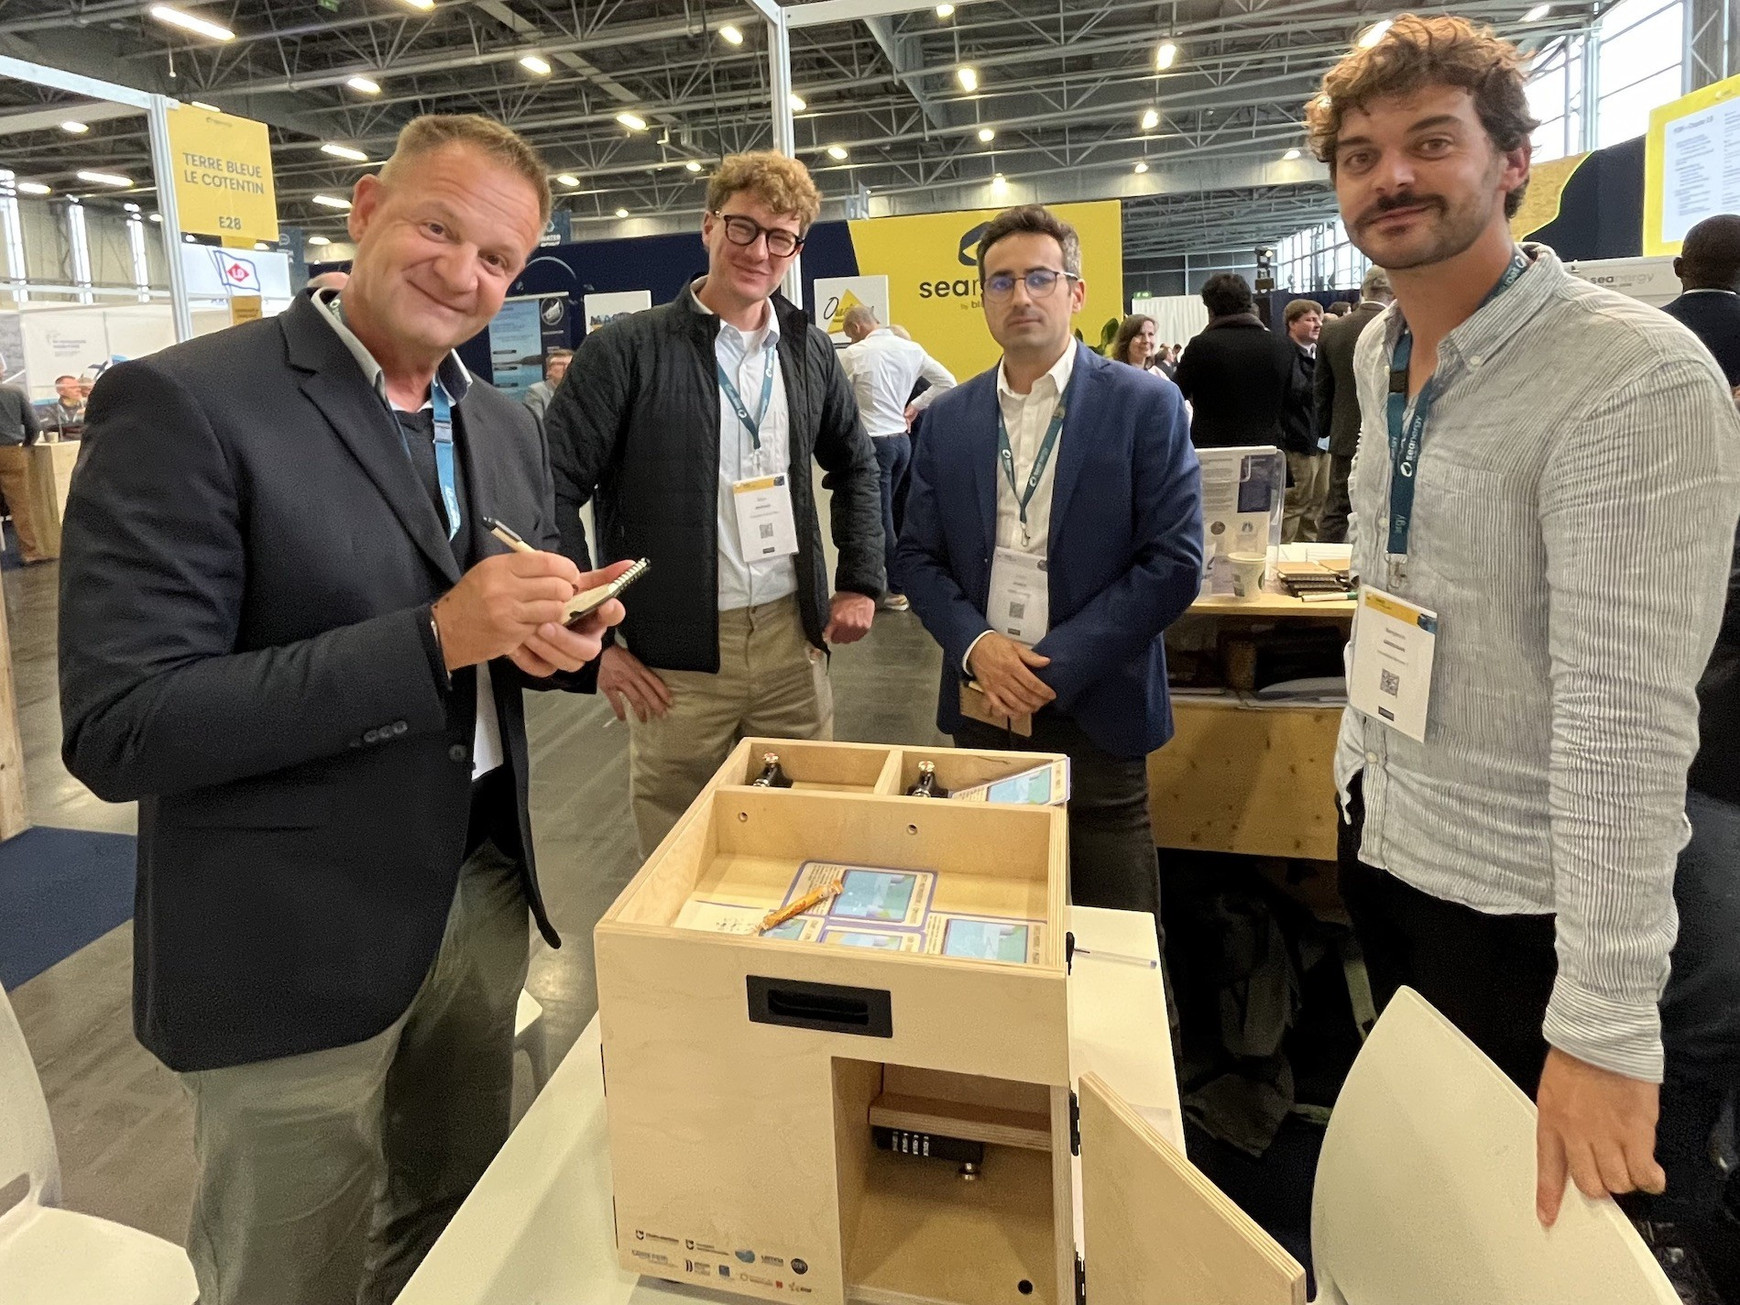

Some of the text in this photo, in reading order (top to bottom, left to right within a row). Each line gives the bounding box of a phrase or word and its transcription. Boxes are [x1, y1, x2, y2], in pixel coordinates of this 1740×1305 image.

[182, 152, 263, 179] TERRE BLEUE
[184, 169, 265, 195] LE COTENTIN
[218, 216, 242, 231] E28
[1406, 413, 1424, 462] seanergy
